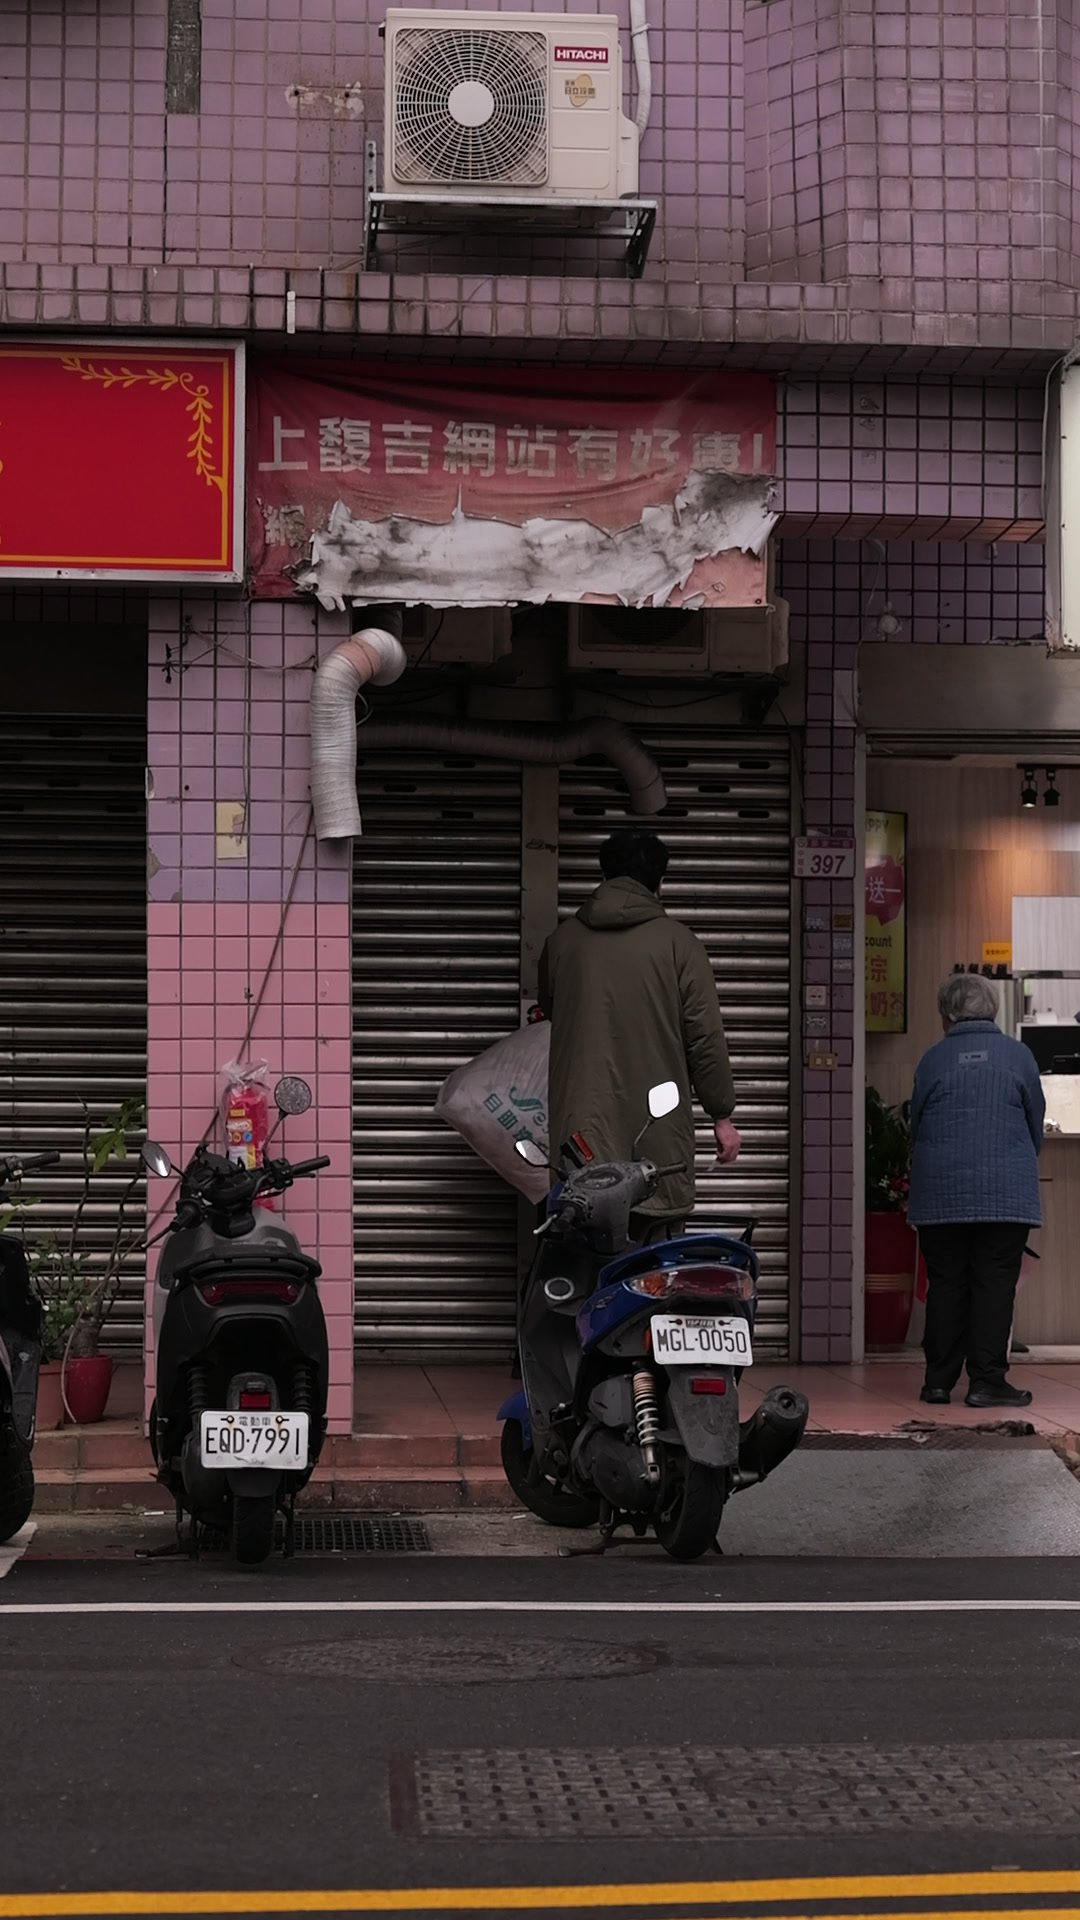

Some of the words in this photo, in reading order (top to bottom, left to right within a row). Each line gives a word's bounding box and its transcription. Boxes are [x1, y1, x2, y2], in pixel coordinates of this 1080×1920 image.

[556, 49, 606, 60] HITACHI
[865, 817, 889, 834] ppy
[810, 854, 846, 875] 397
[865, 876, 901, 904] 送一
[483, 1092, 549, 1153] 自助洗
[238, 1416, 271, 1427] 電動車
